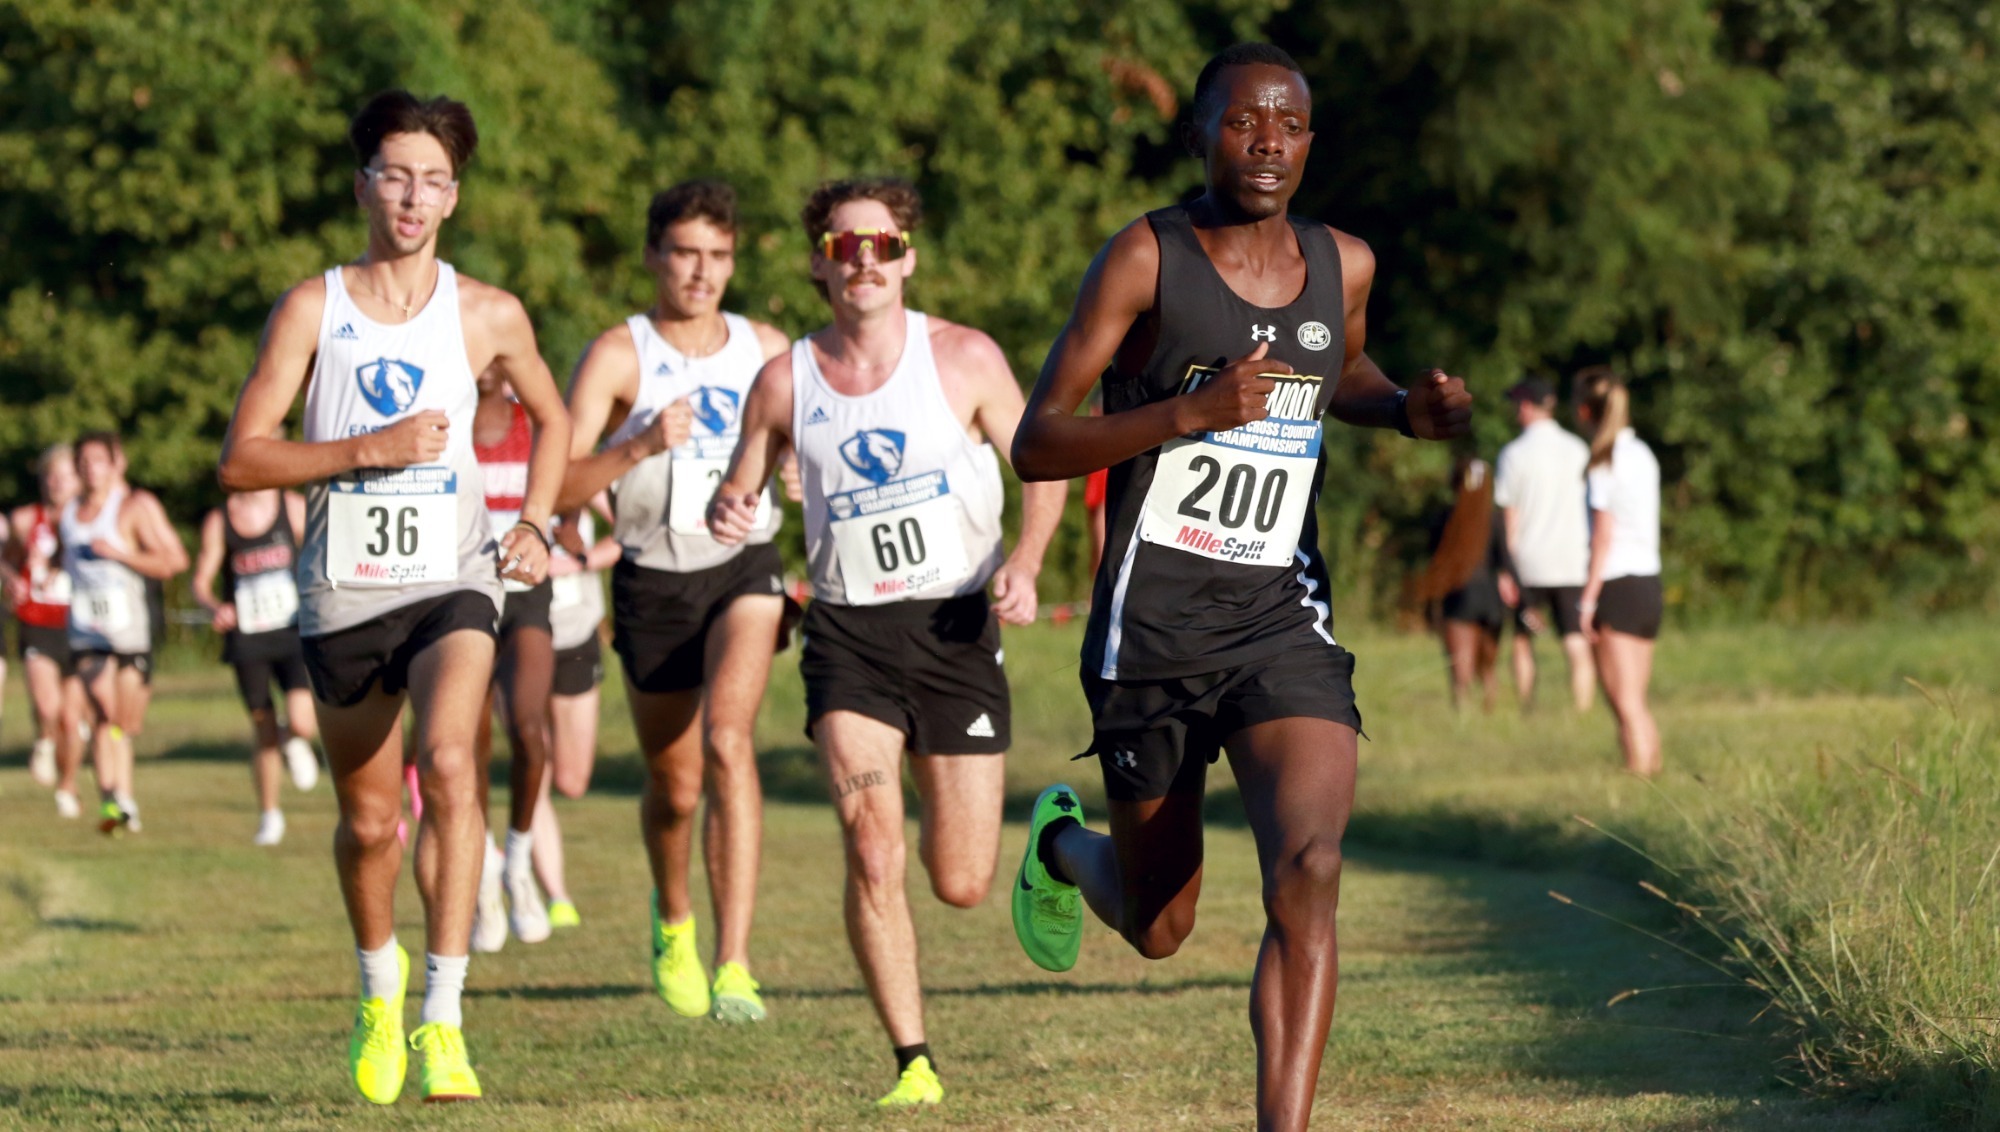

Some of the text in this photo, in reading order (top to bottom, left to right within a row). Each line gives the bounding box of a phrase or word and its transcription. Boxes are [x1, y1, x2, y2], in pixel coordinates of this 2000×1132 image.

[1213, 430, 1308, 455] CHAMPIONSHIPS
[1245, 420, 1281, 436] CROSS
[1280, 423, 1318, 440] COUNTRY
[363, 481, 446, 495] CHAMPIONSHIPS
[415, 469, 453, 483] COUNTRY
[858, 485, 940, 515] CHAMPIONSHIPS
[1177, 454, 1289, 533] 200
[366, 506, 419, 557] 36
[871, 516, 927, 574] 60
[1175, 525, 1267, 561] MileSplit
[354, 562, 428, 583] MileSplit
[873, 566, 941, 598] MileSplit
[835, 770, 888, 799] LIEBE
